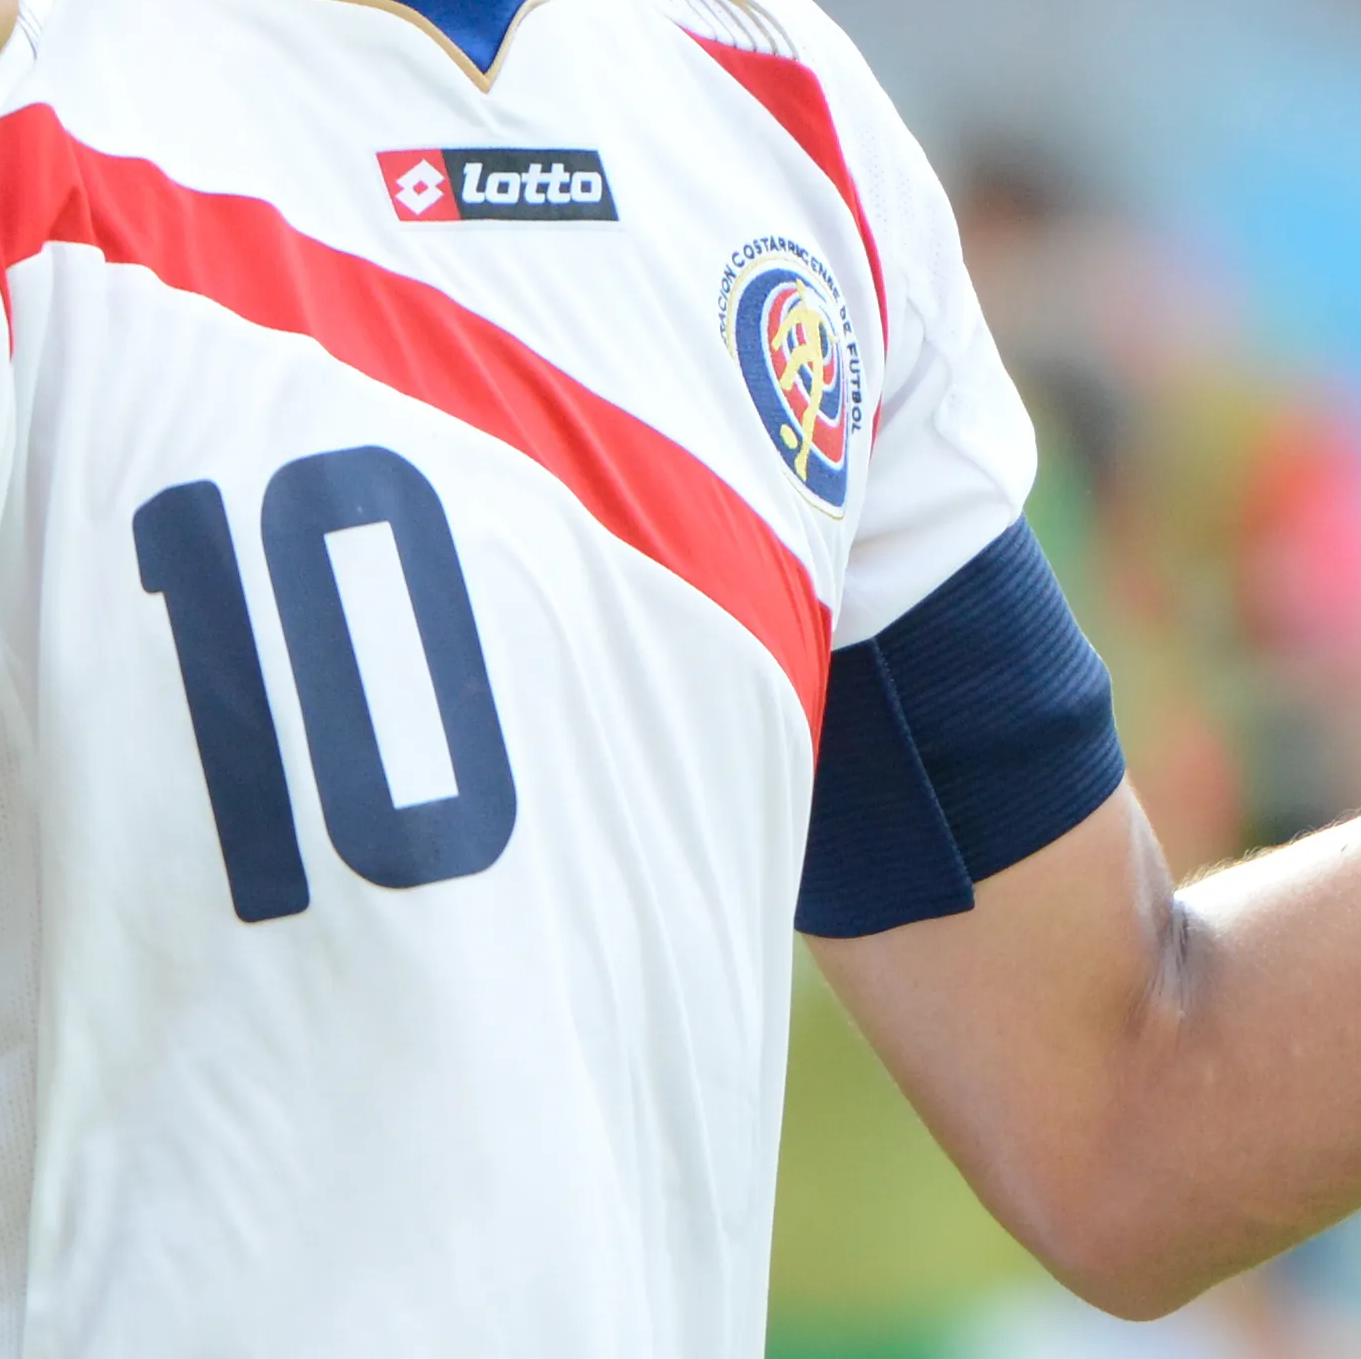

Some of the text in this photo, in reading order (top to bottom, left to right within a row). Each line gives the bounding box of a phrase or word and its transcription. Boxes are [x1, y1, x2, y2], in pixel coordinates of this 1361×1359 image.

[461, 162, 602, 205] lotto
[846, 342, 863, 435] FUTBOL
[132, 444, 518, 924] 10
